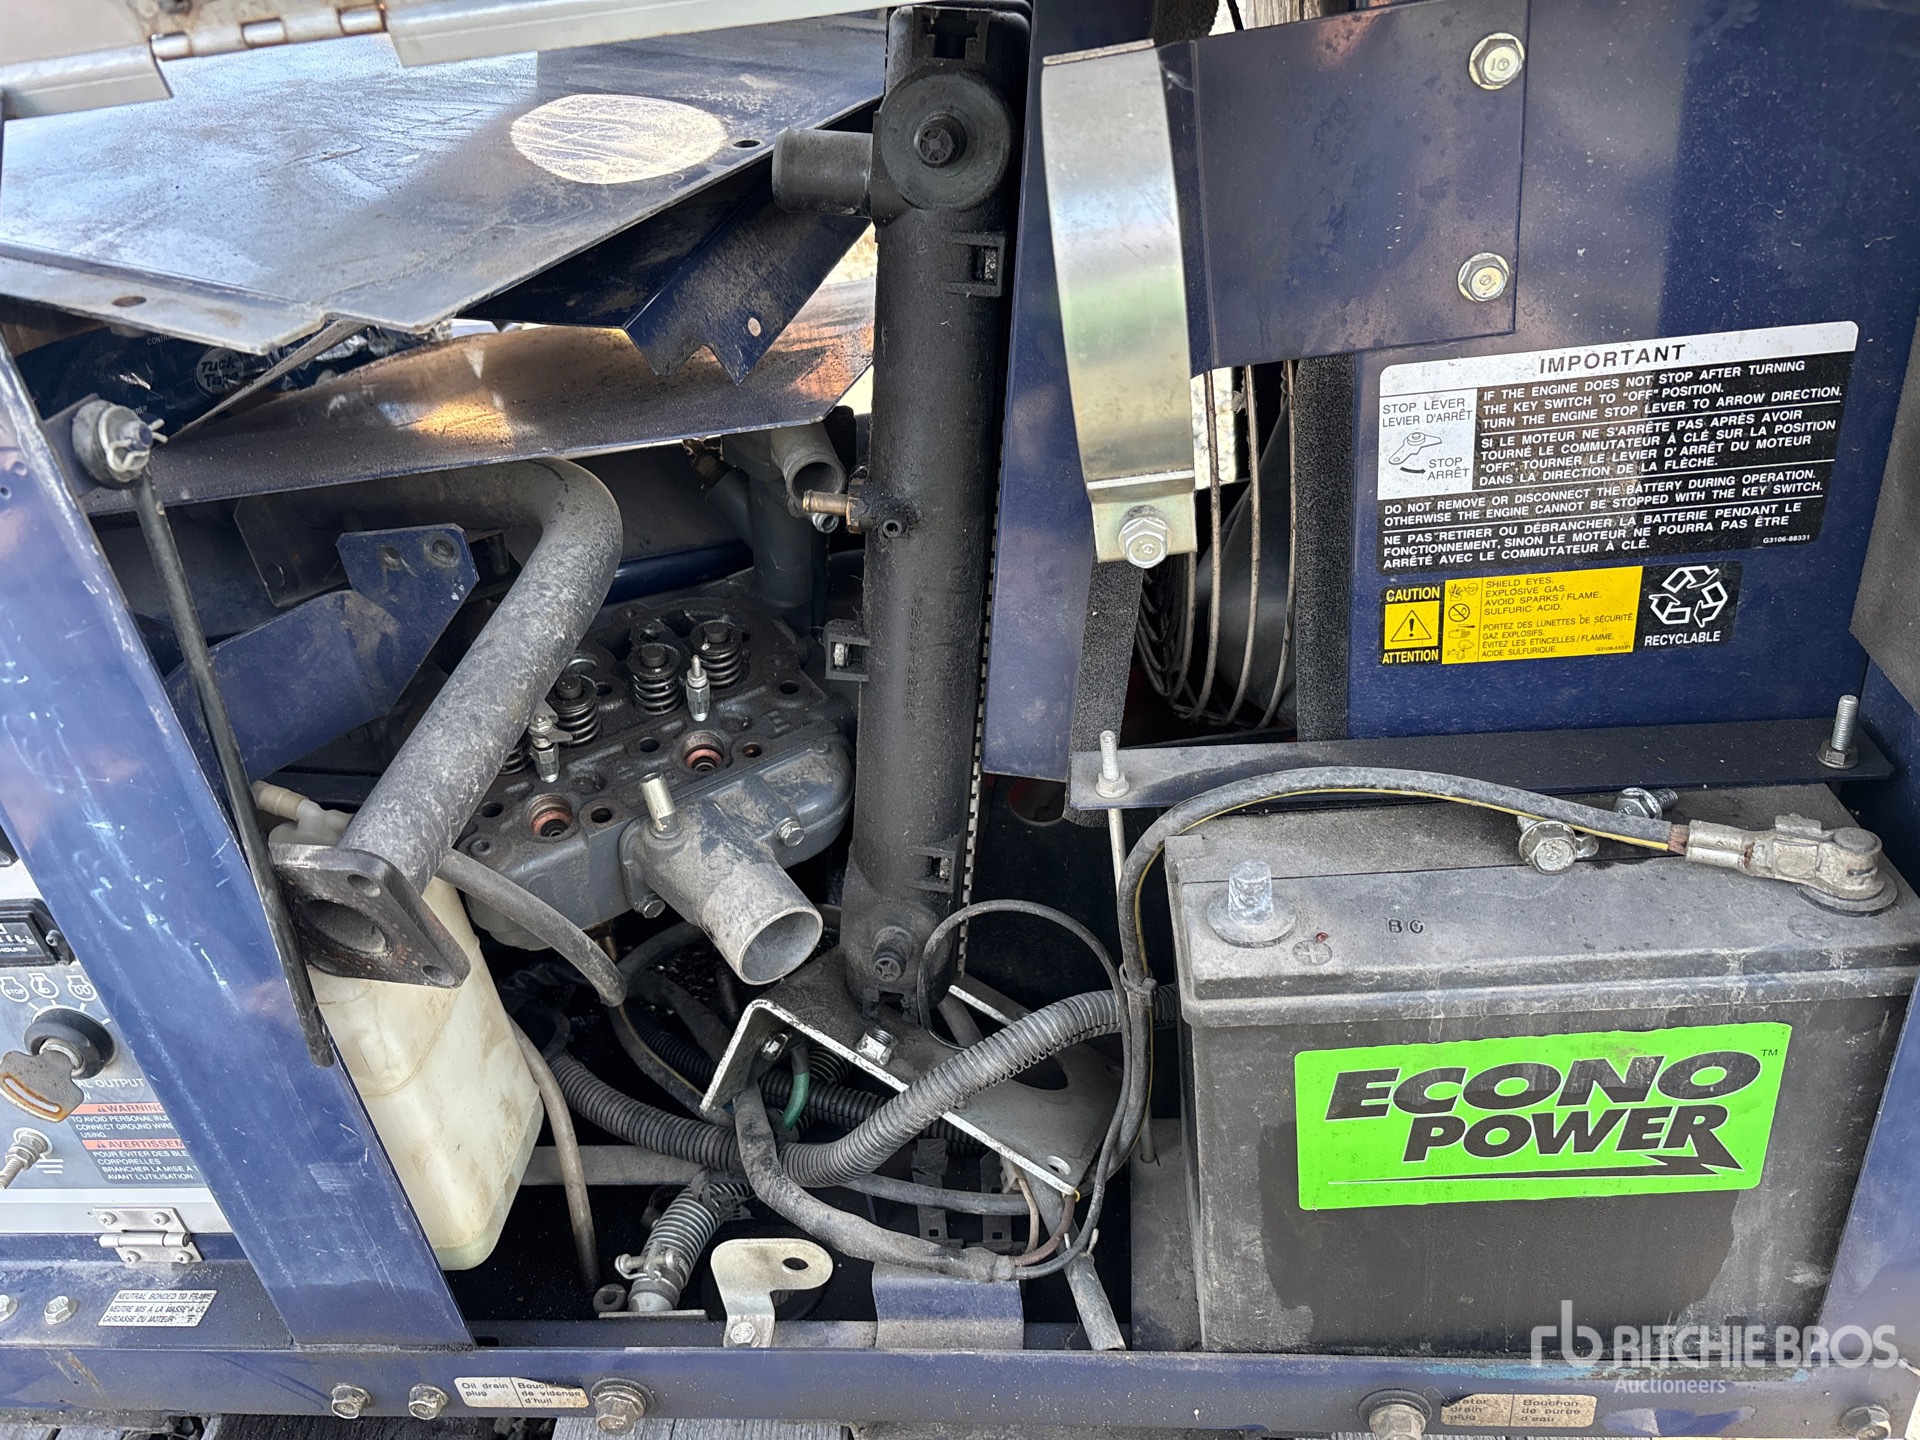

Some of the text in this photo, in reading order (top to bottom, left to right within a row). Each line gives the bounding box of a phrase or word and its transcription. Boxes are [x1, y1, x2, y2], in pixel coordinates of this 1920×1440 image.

[1539, 345, 1686, 374] IMPORTANT
[1483, 360, 1805, 400] IF THE ENGINE DOES NOT STOP AFTER TURNING
[1382, 397, 1465, 414] STOP LEVER
[1482, 387, 1842, 429] TURN THE ENGINE STOP LEVER TO ARROW DIRECTION.
[1483, 383, 1724, 415] THE KEY SWITCH TO "OFF" POSITION.
[1382, 407, 1472, 428] LEVIER D'ARRÊT
[1481, 409, 1803, 448] SI LE MOTEUR NE S'ARRÊTE PAS APRÈS AVOIR
[1480, 420, 1836, 461] TOURNÉ LE COMMUTATEUR CLÉ SUR LA POSITION
[1428, 456, 1462, 469] STOP
[1522, 456, 1582, 470] TOURNER
[1588, 454, 1606, 464] LE
[1612, 449, 1657, 462] LEVIER
[1729, 441, 1751, 452] DU
[1755, 436, 1811, 449] MOTEUR
[1427, 465, 1470, 480] ARRÊT
[1479, 454, 1718, 486] DANS LA DIRECTION DE LA FLÈCHE.
[1384, 469, 1816, 515] DO NOT REMOVE OR DISCONNECT THE BATTERY DURING OPERATION.
[1384, 481, 1823, 526] OTHERWISE THE ENGINE CANNOT BE STOPPED WITH THE KEY SWITCH.
[1384, 502, 1801, 545] NE PAS RETIRER OU DÉBRANCHER LA BATTERIE PENDANT LE
[1384, 513, 1789, 556] FONCTIONNEMENT, SINON LE MOTEUR NE POURRA PAS ÊTRE
[1384, 536, 1650, 567] ARRÊTÉ AVEC LE COMMUTATEUR CLÉ.
[1485, 587, 1540, 596] EXPLOSIVE
[1486, 577, 1553, 587] SHIELD EYES.
[1386, 586, 1439, 602] CAUTION
[1484, 597, 1515, 605] AVOID
[1519, 594, 1558, 603] SPARKS
[1484, 603, 1562, 614] SULFURIC ACID.
[1483, 622, 1512, 630] PORTEZ
[1535, 618, 1575, 627] LUNETTES
[1482, 639, 1508, 648] ÉVITEZ
[1644, 630, 1721, 647] RECYCLABLE
[1382, 648, 1438, 664] ATTENTION
[1481, 649, 1505, 657] ACIDE
[95, 1078, 145, 1088] OUTPUT
[1324, 1051, 1762, 1121] ECONO
[1402, 1105, 1744, 1171] POWER
[1523, 1399, 1579, 1407] Bouchon
